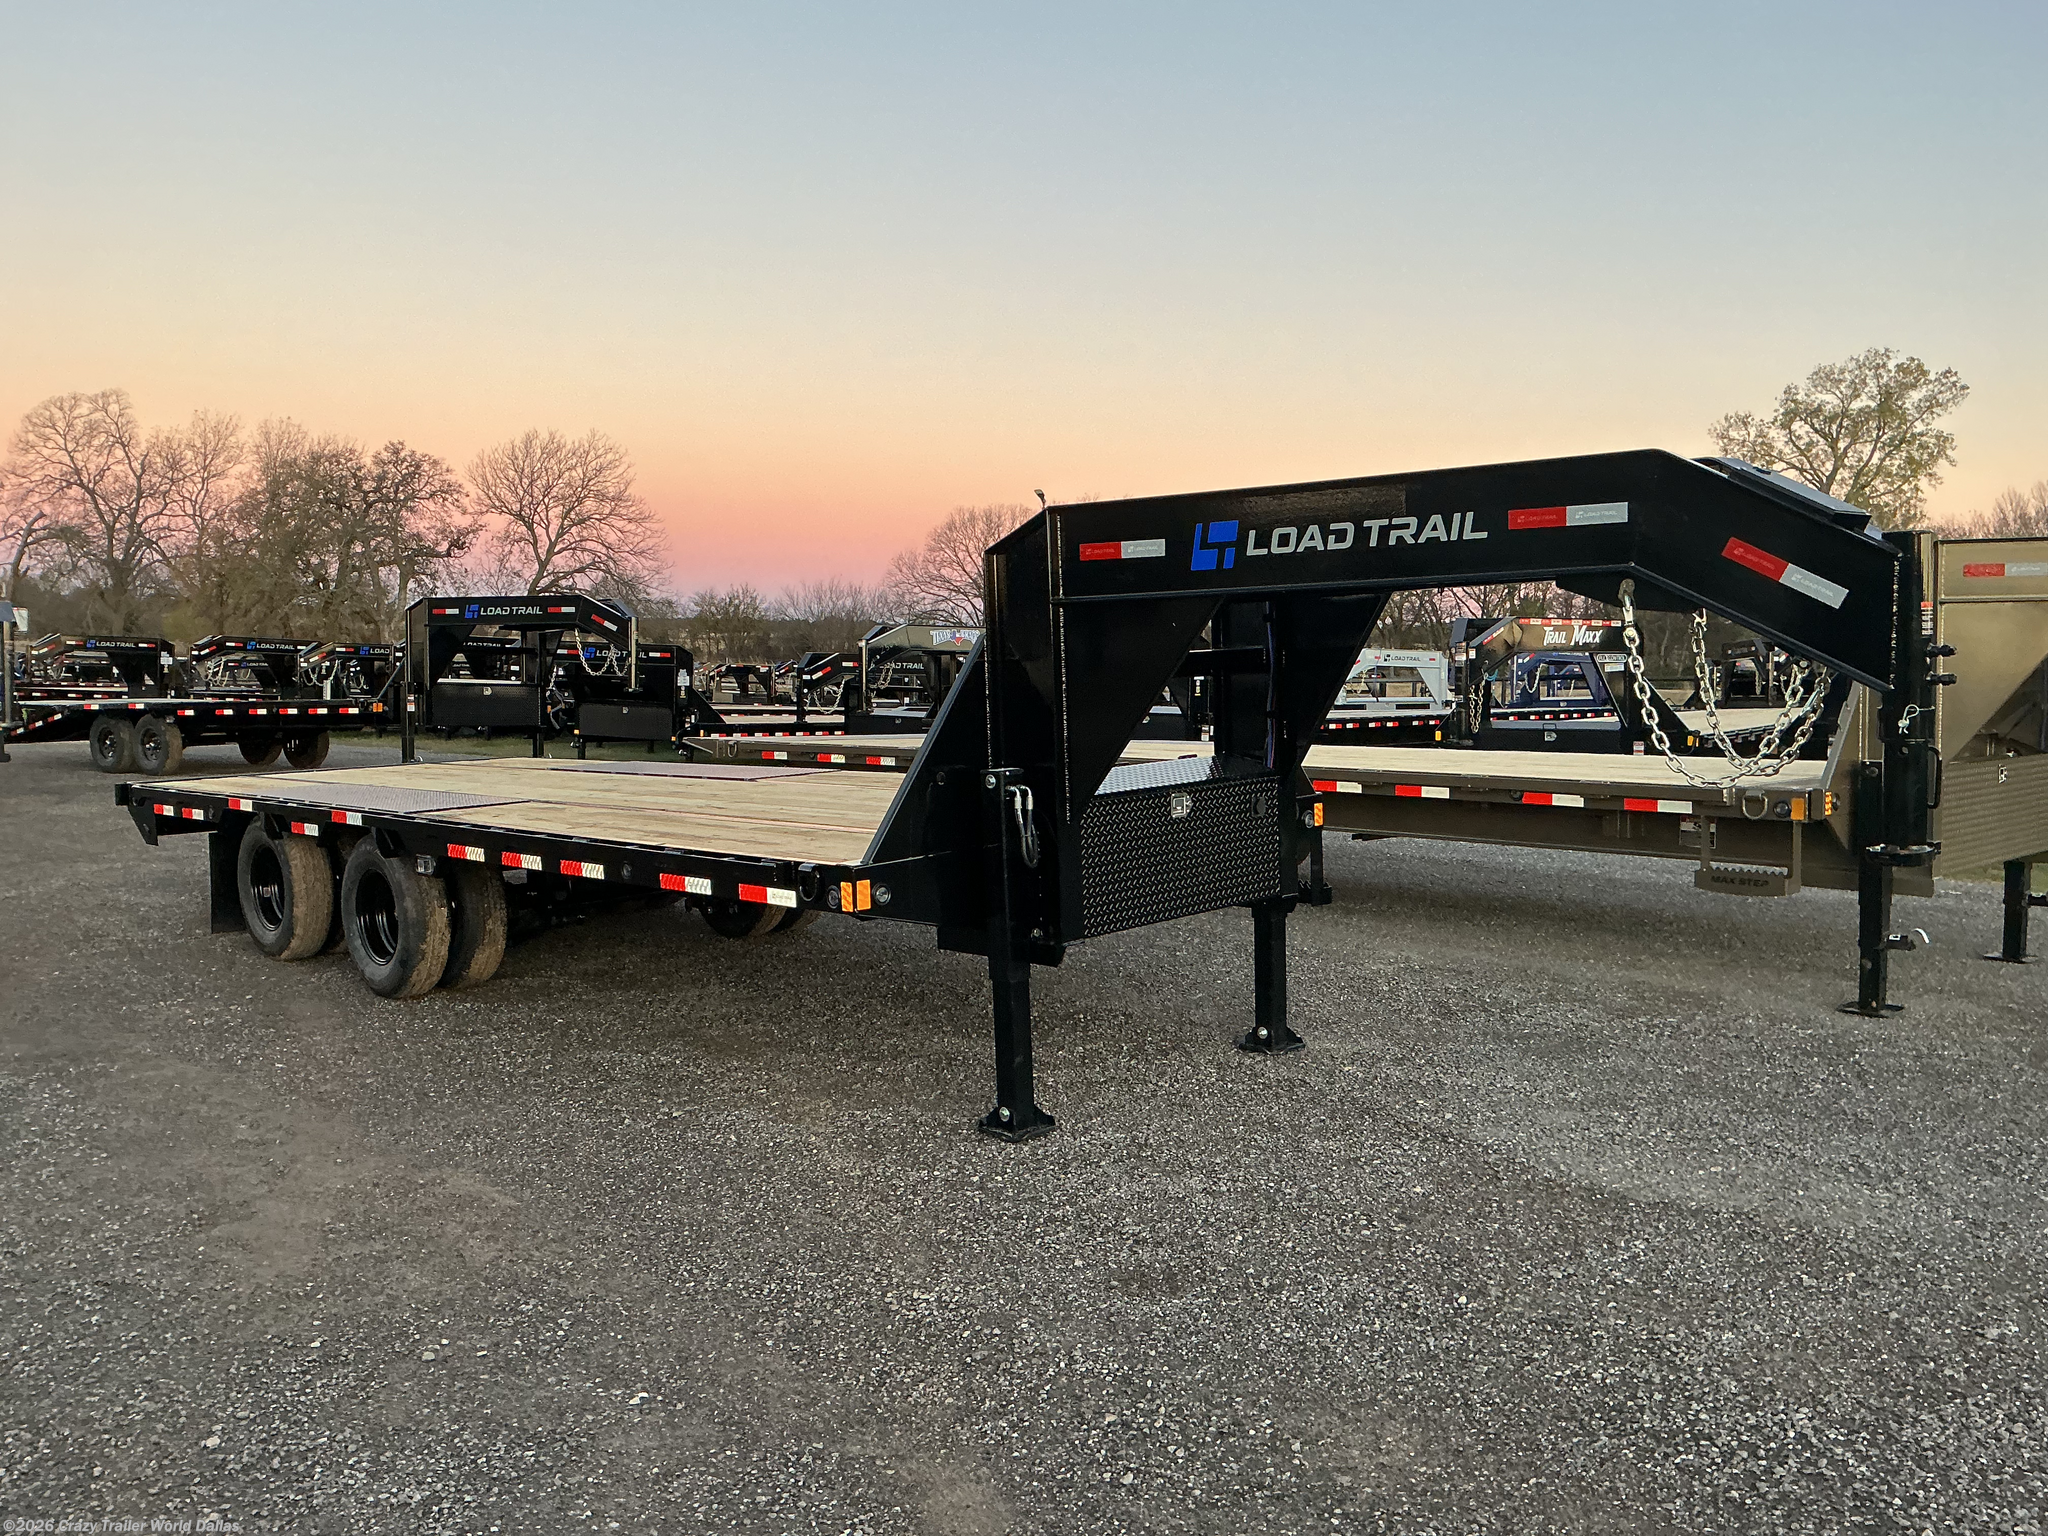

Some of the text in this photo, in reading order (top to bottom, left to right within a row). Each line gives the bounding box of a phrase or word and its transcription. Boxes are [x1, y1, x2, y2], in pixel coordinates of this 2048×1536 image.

[1246, 521, 1355, 556] LOAD
[1363, 511, 1488, 547] TRAIL
[480, 606, 543, 615] LOAD TRAIL
[622, 651, 647, 659] TIL
[1711, 875, 1770, 887] MAX STEP
